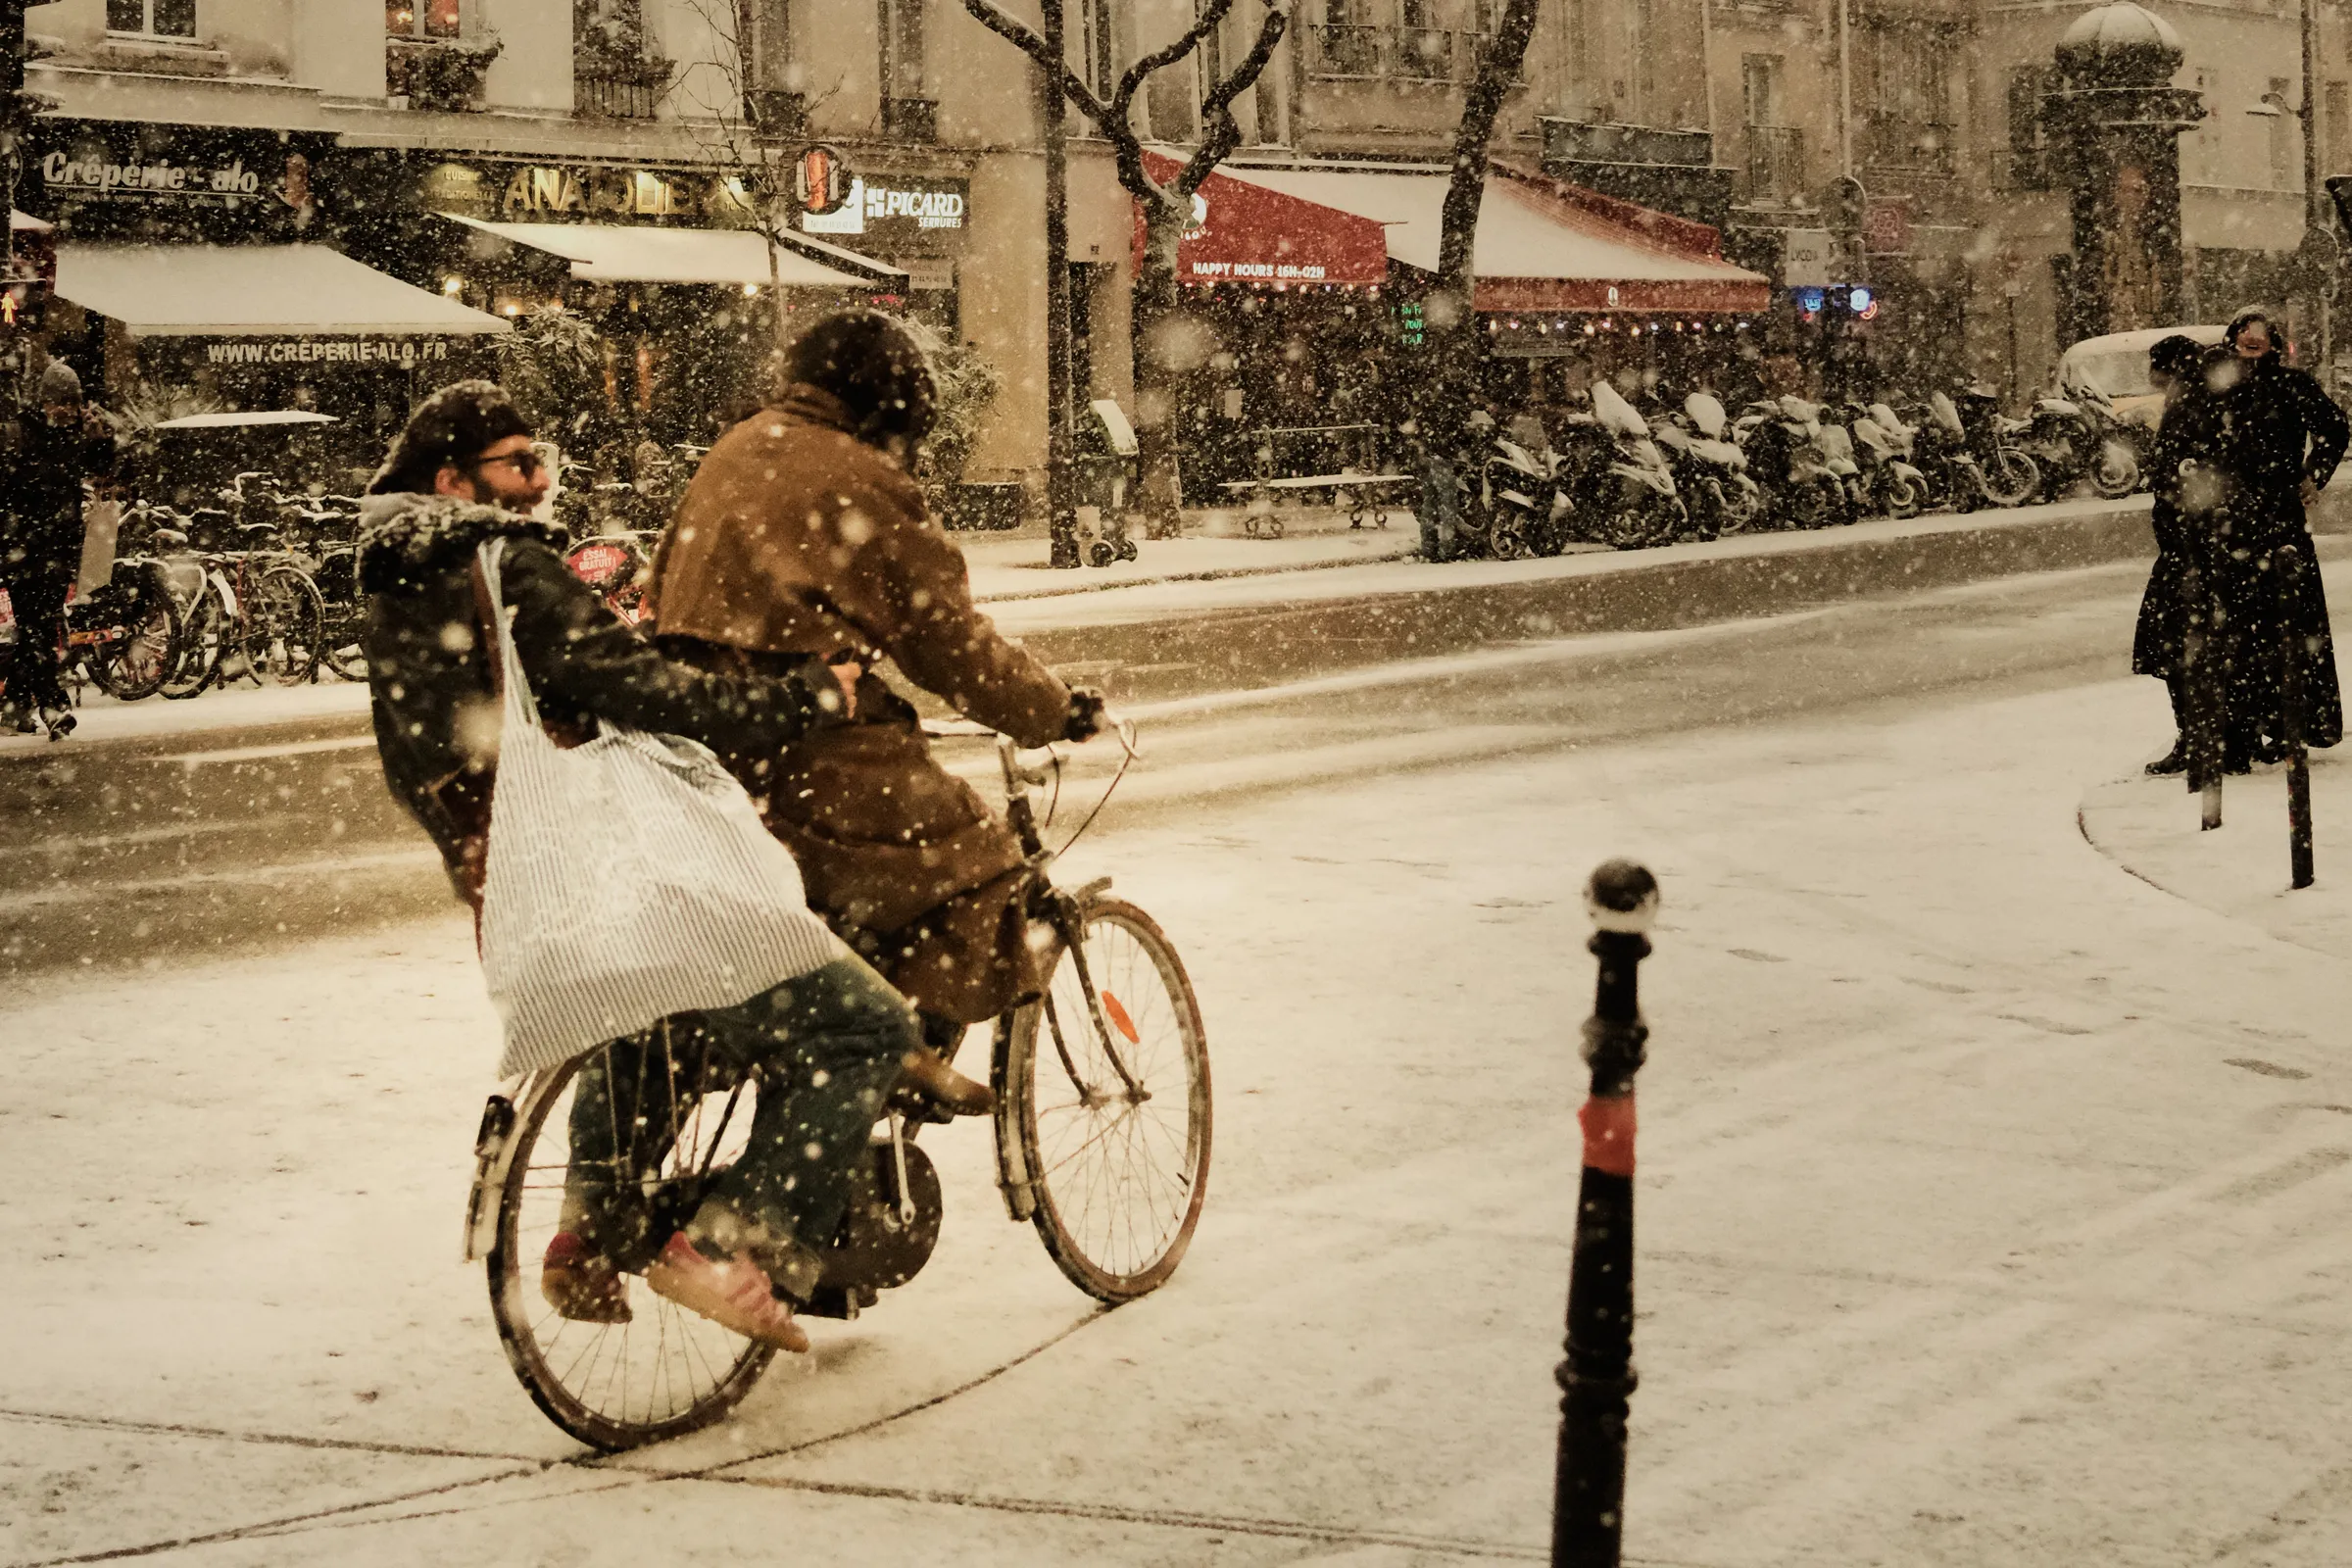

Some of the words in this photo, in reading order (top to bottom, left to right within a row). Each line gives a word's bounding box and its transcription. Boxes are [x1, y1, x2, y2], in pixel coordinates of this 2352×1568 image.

[212, 161, 259, 193] alo
[886, 191, 963, 217] PICARD
[918, 217, 962, 228] SERRURES
[1193, 262, 1232, 275] HAPPY
[1234, 264, 1274, 277] HOURS
[1277, 266, 1325, 279] 16H-02H
